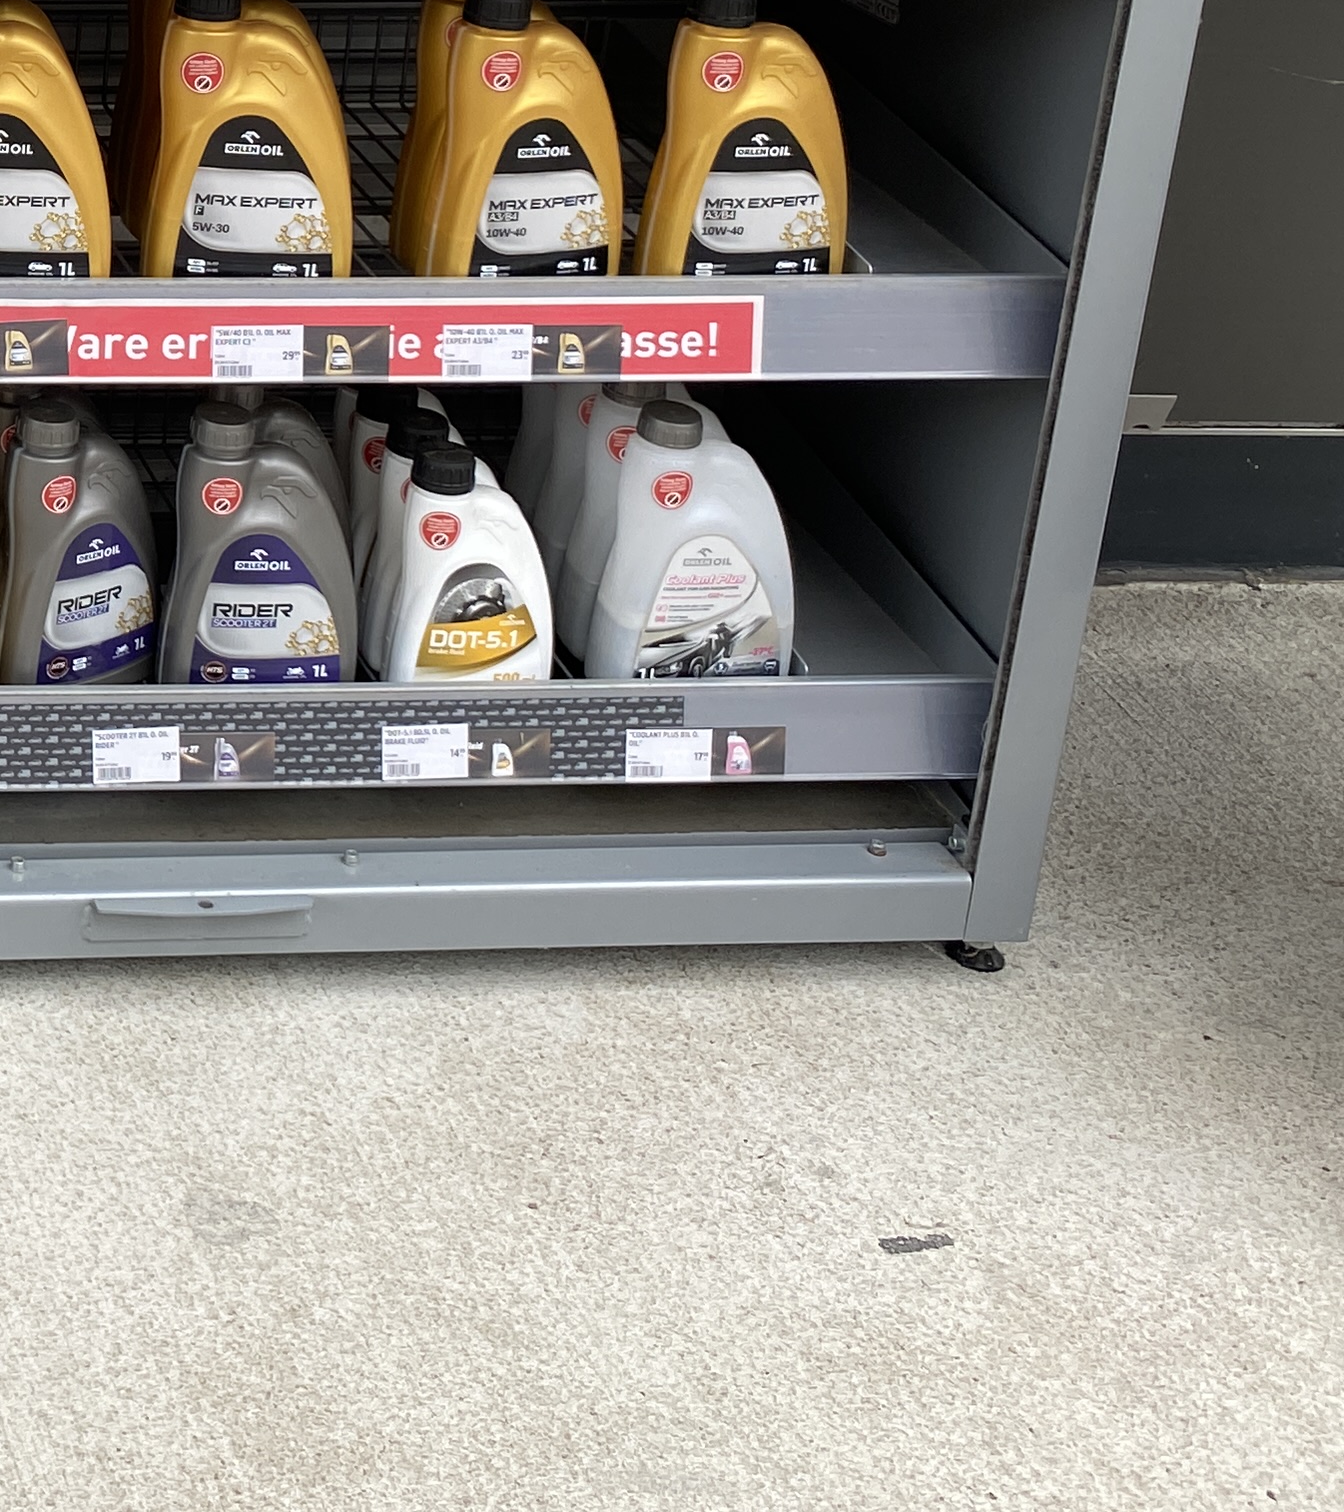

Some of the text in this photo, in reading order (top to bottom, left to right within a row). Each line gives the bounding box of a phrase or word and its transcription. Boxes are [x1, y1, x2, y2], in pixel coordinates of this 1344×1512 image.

[10, 143, 34, 155] OIL
[261, 144, 284, 156] OIL
[550, 145, 572, 157] OIL
[770, 145, 792, 157] OIL
[194, 193, 318, 210] MAX EXPERT
[488, 193, 598, 212] MAX EXPERT
[704, 194, 819, 210] MAX EXPERT
[192, 222, 230, 234] 5W-30
[485, 227, 527, 238] 10W-40
[701, 226, 744, 236] 10W-40
[58, 262, 75, 277] 1L
[302, 263, 319, 277] 1L
[103, 544, 121, 558] OIL
[269, 559, 291, 571] OIL
[665, 573, 746, 585] Coolant Plus
[57, 585, 123, 615] RIDER
[212, 603, 294, 618] RIDER
[213, 618, 261, 628] SCOOTER
[429, 628, 519, 649] DOT-5.1
[312, 664, 328, 678] 1L
